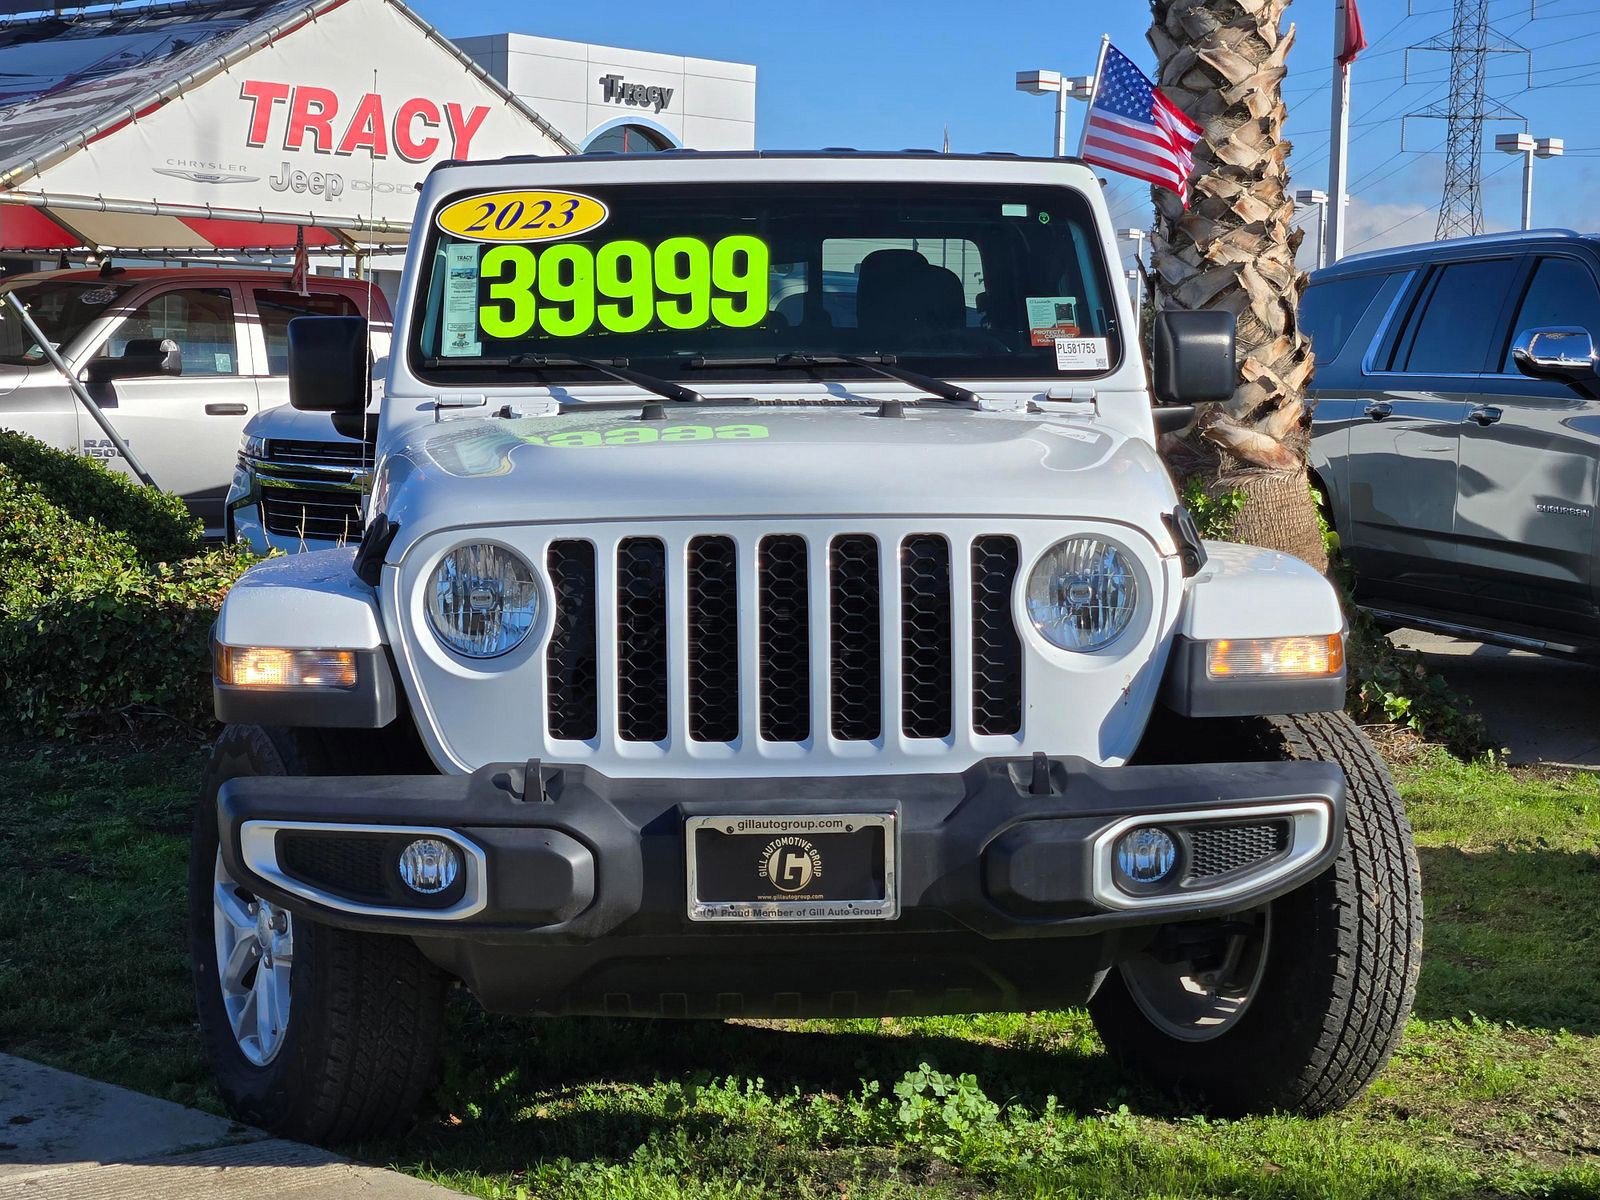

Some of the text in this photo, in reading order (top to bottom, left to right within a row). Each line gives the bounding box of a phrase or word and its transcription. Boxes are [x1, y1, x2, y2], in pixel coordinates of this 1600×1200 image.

[602, 74, 674, 111] Tracy
[239, 80, 491, 164] TRACY
[166, 158, 248, 172] CHRYSLER
[269, 162, 344, 201] Jeep
[351, 179, 416, 194] DOD
[464, 199, 580, 232] 2023
[479, 235, 769, 338] 39999
[1057, 343, 1096, 354] PL581753
[1536, 504, 1590, 517] SUBURBAN
[737, 819, 843, 831] gillautogroup.com
[758, 836, 822, 877] GILL AUTOMOTIVE GROUP
[721, 909, 750, 917] Proud
[753, 908, 793, 917] Member
[796, 908, 806, 916] of
[809, 908, 825, 916] Gill
[827, 907, 850, 916] Auto
[852, 907, 882, 917] Group
